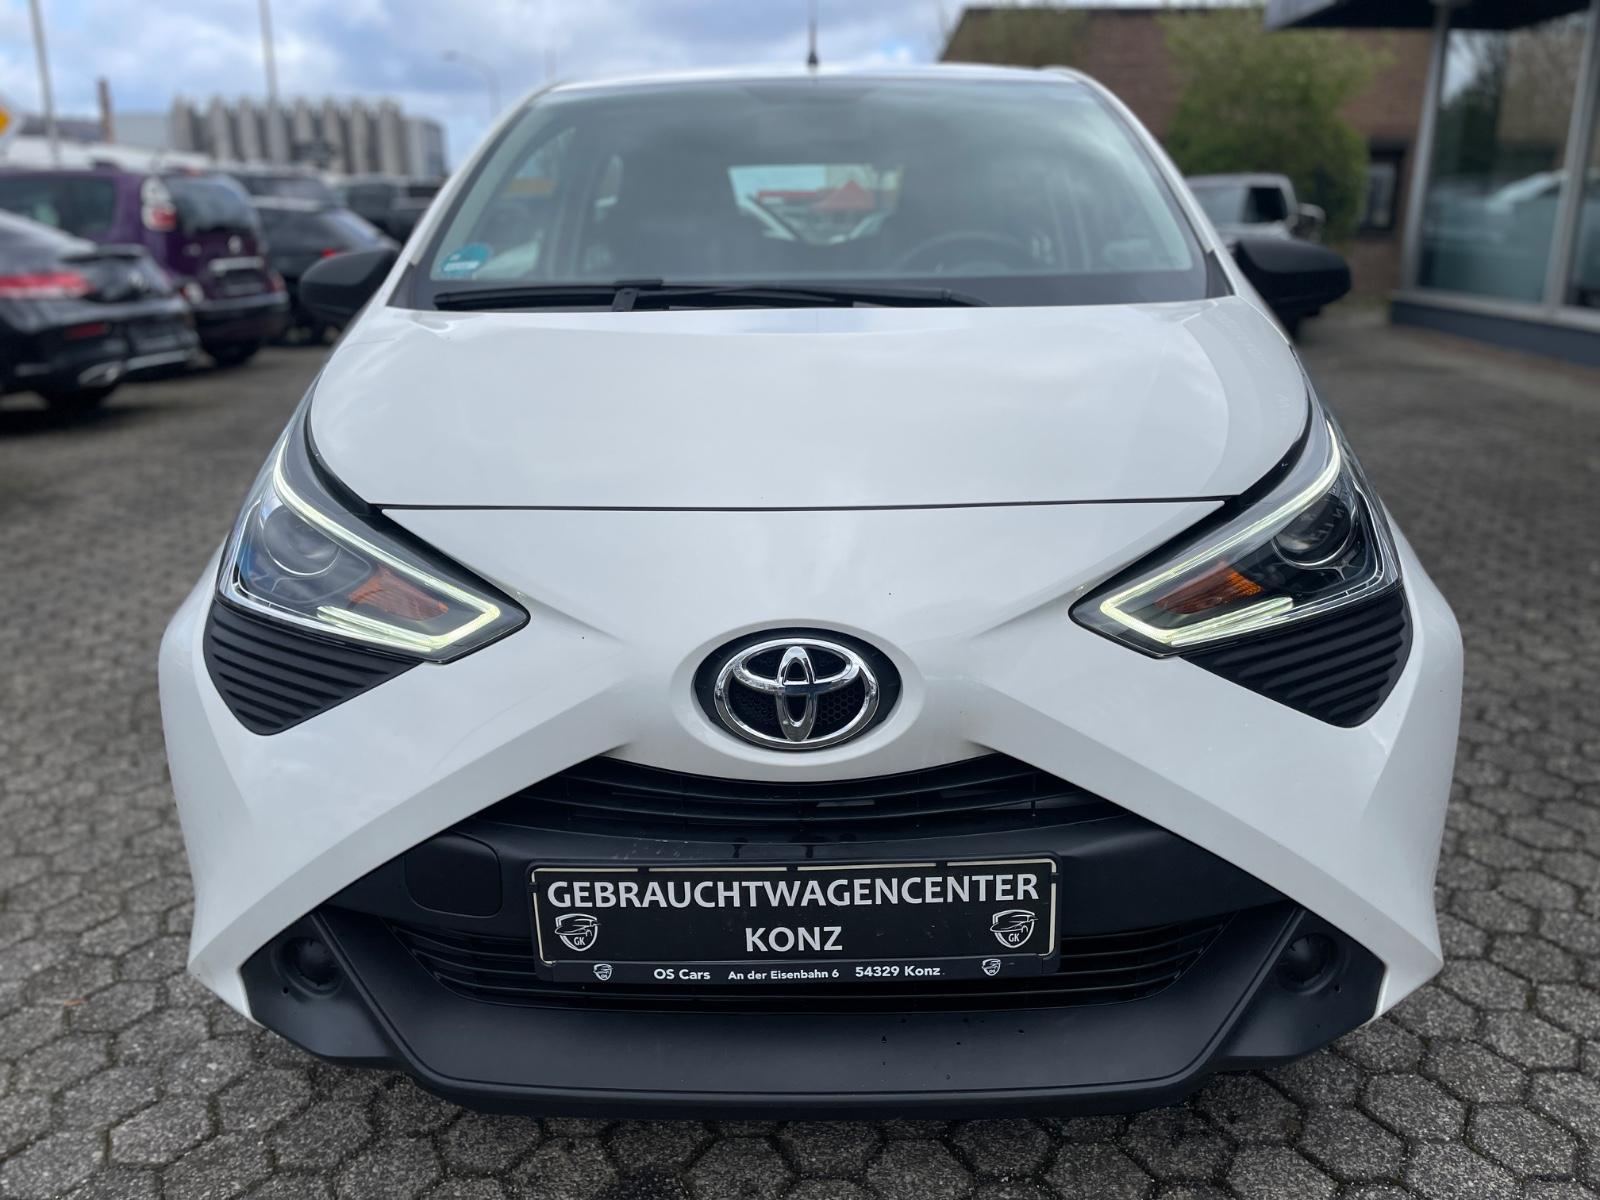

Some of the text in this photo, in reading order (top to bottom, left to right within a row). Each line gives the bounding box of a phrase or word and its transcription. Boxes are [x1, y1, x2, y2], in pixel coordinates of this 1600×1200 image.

[547, 873, 1039, 908] GEBRAUCHTWAGENCENTER
[573, 936, 586, 946] GK
[745, 926, 843, 952] KONZ
[1008, 933, 1020, 943] GK
[653, 968, 711, 980] OS Cars
[728, 969, 840, 980] An der Eisenbahn 6
[855, 965, 941, 977] 54329 Konz
